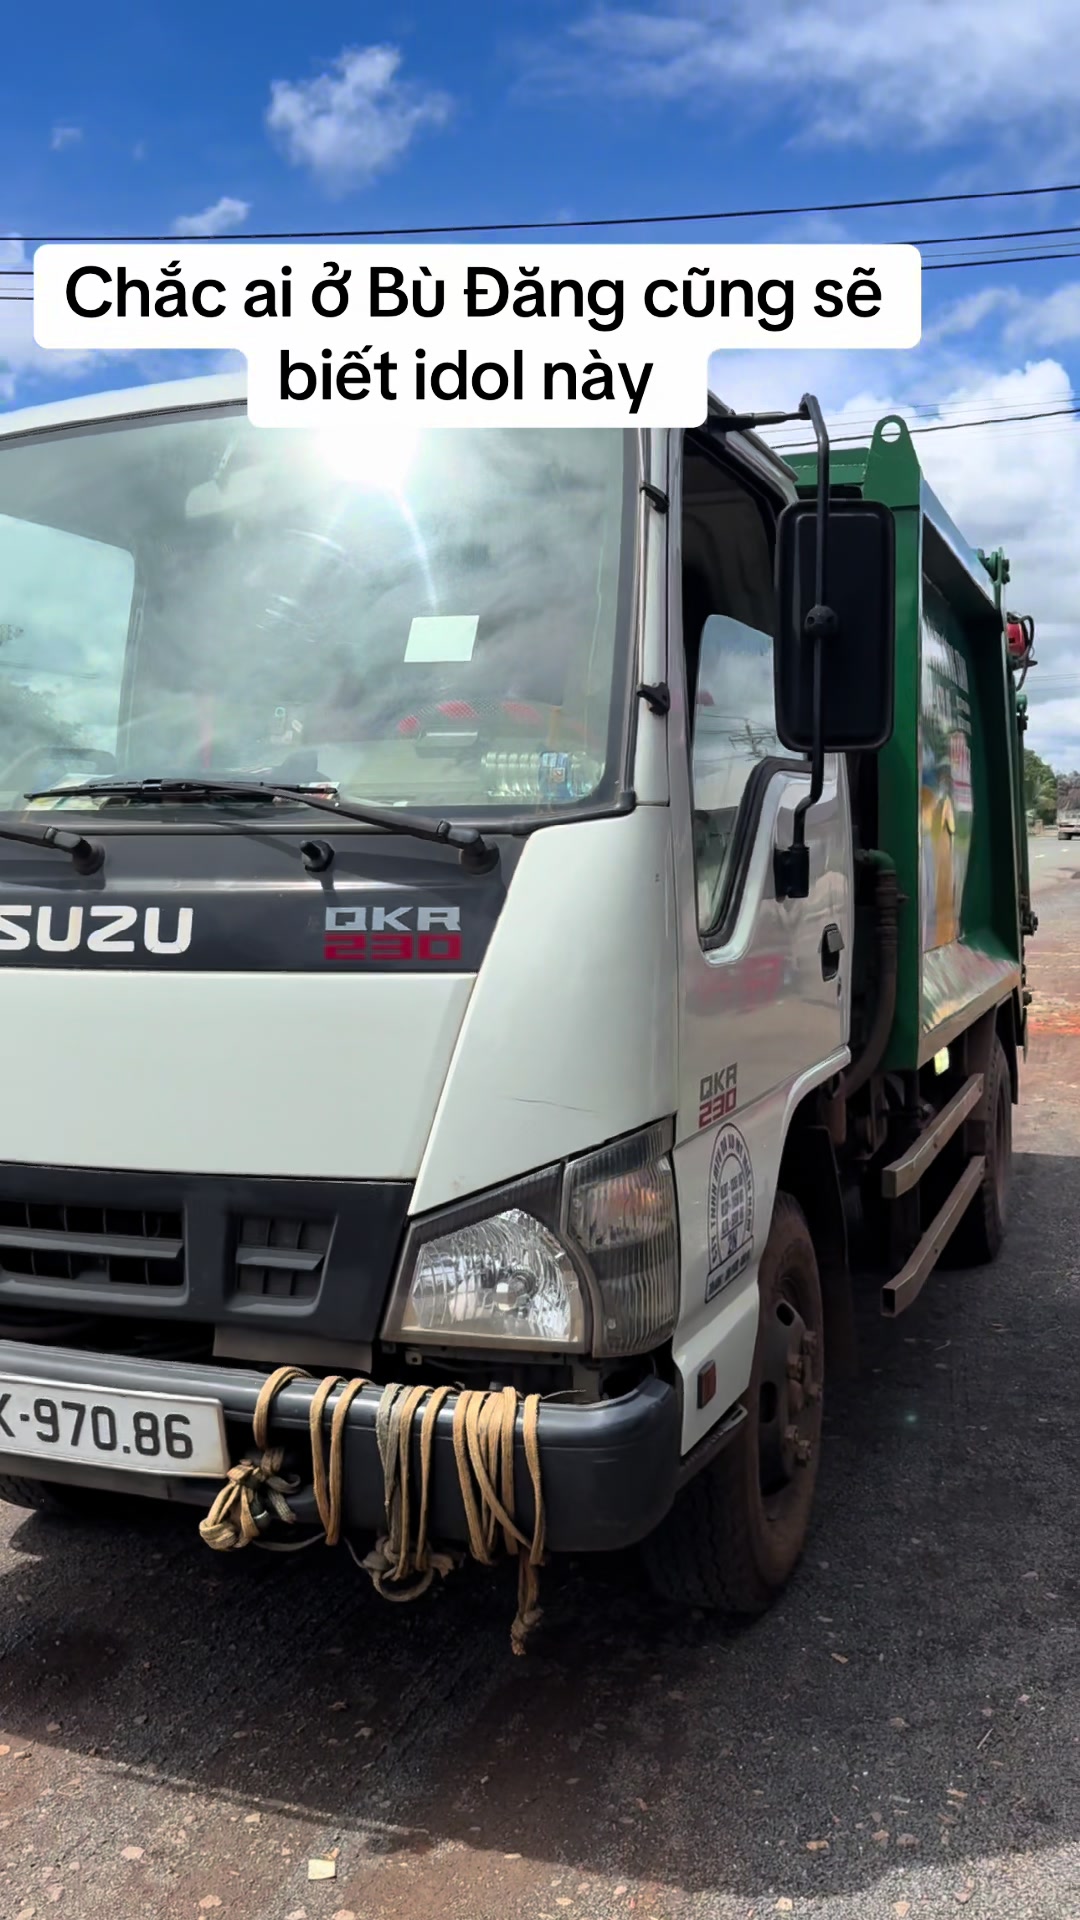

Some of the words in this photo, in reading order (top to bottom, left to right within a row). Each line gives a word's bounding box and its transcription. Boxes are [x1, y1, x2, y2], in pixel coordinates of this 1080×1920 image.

[324, 906, 461, 932] QKR
[323, 933, 462, 961] 230
[699, 1062, 738, 1102] QKR
[698, 1087, 738, 1129] 230
